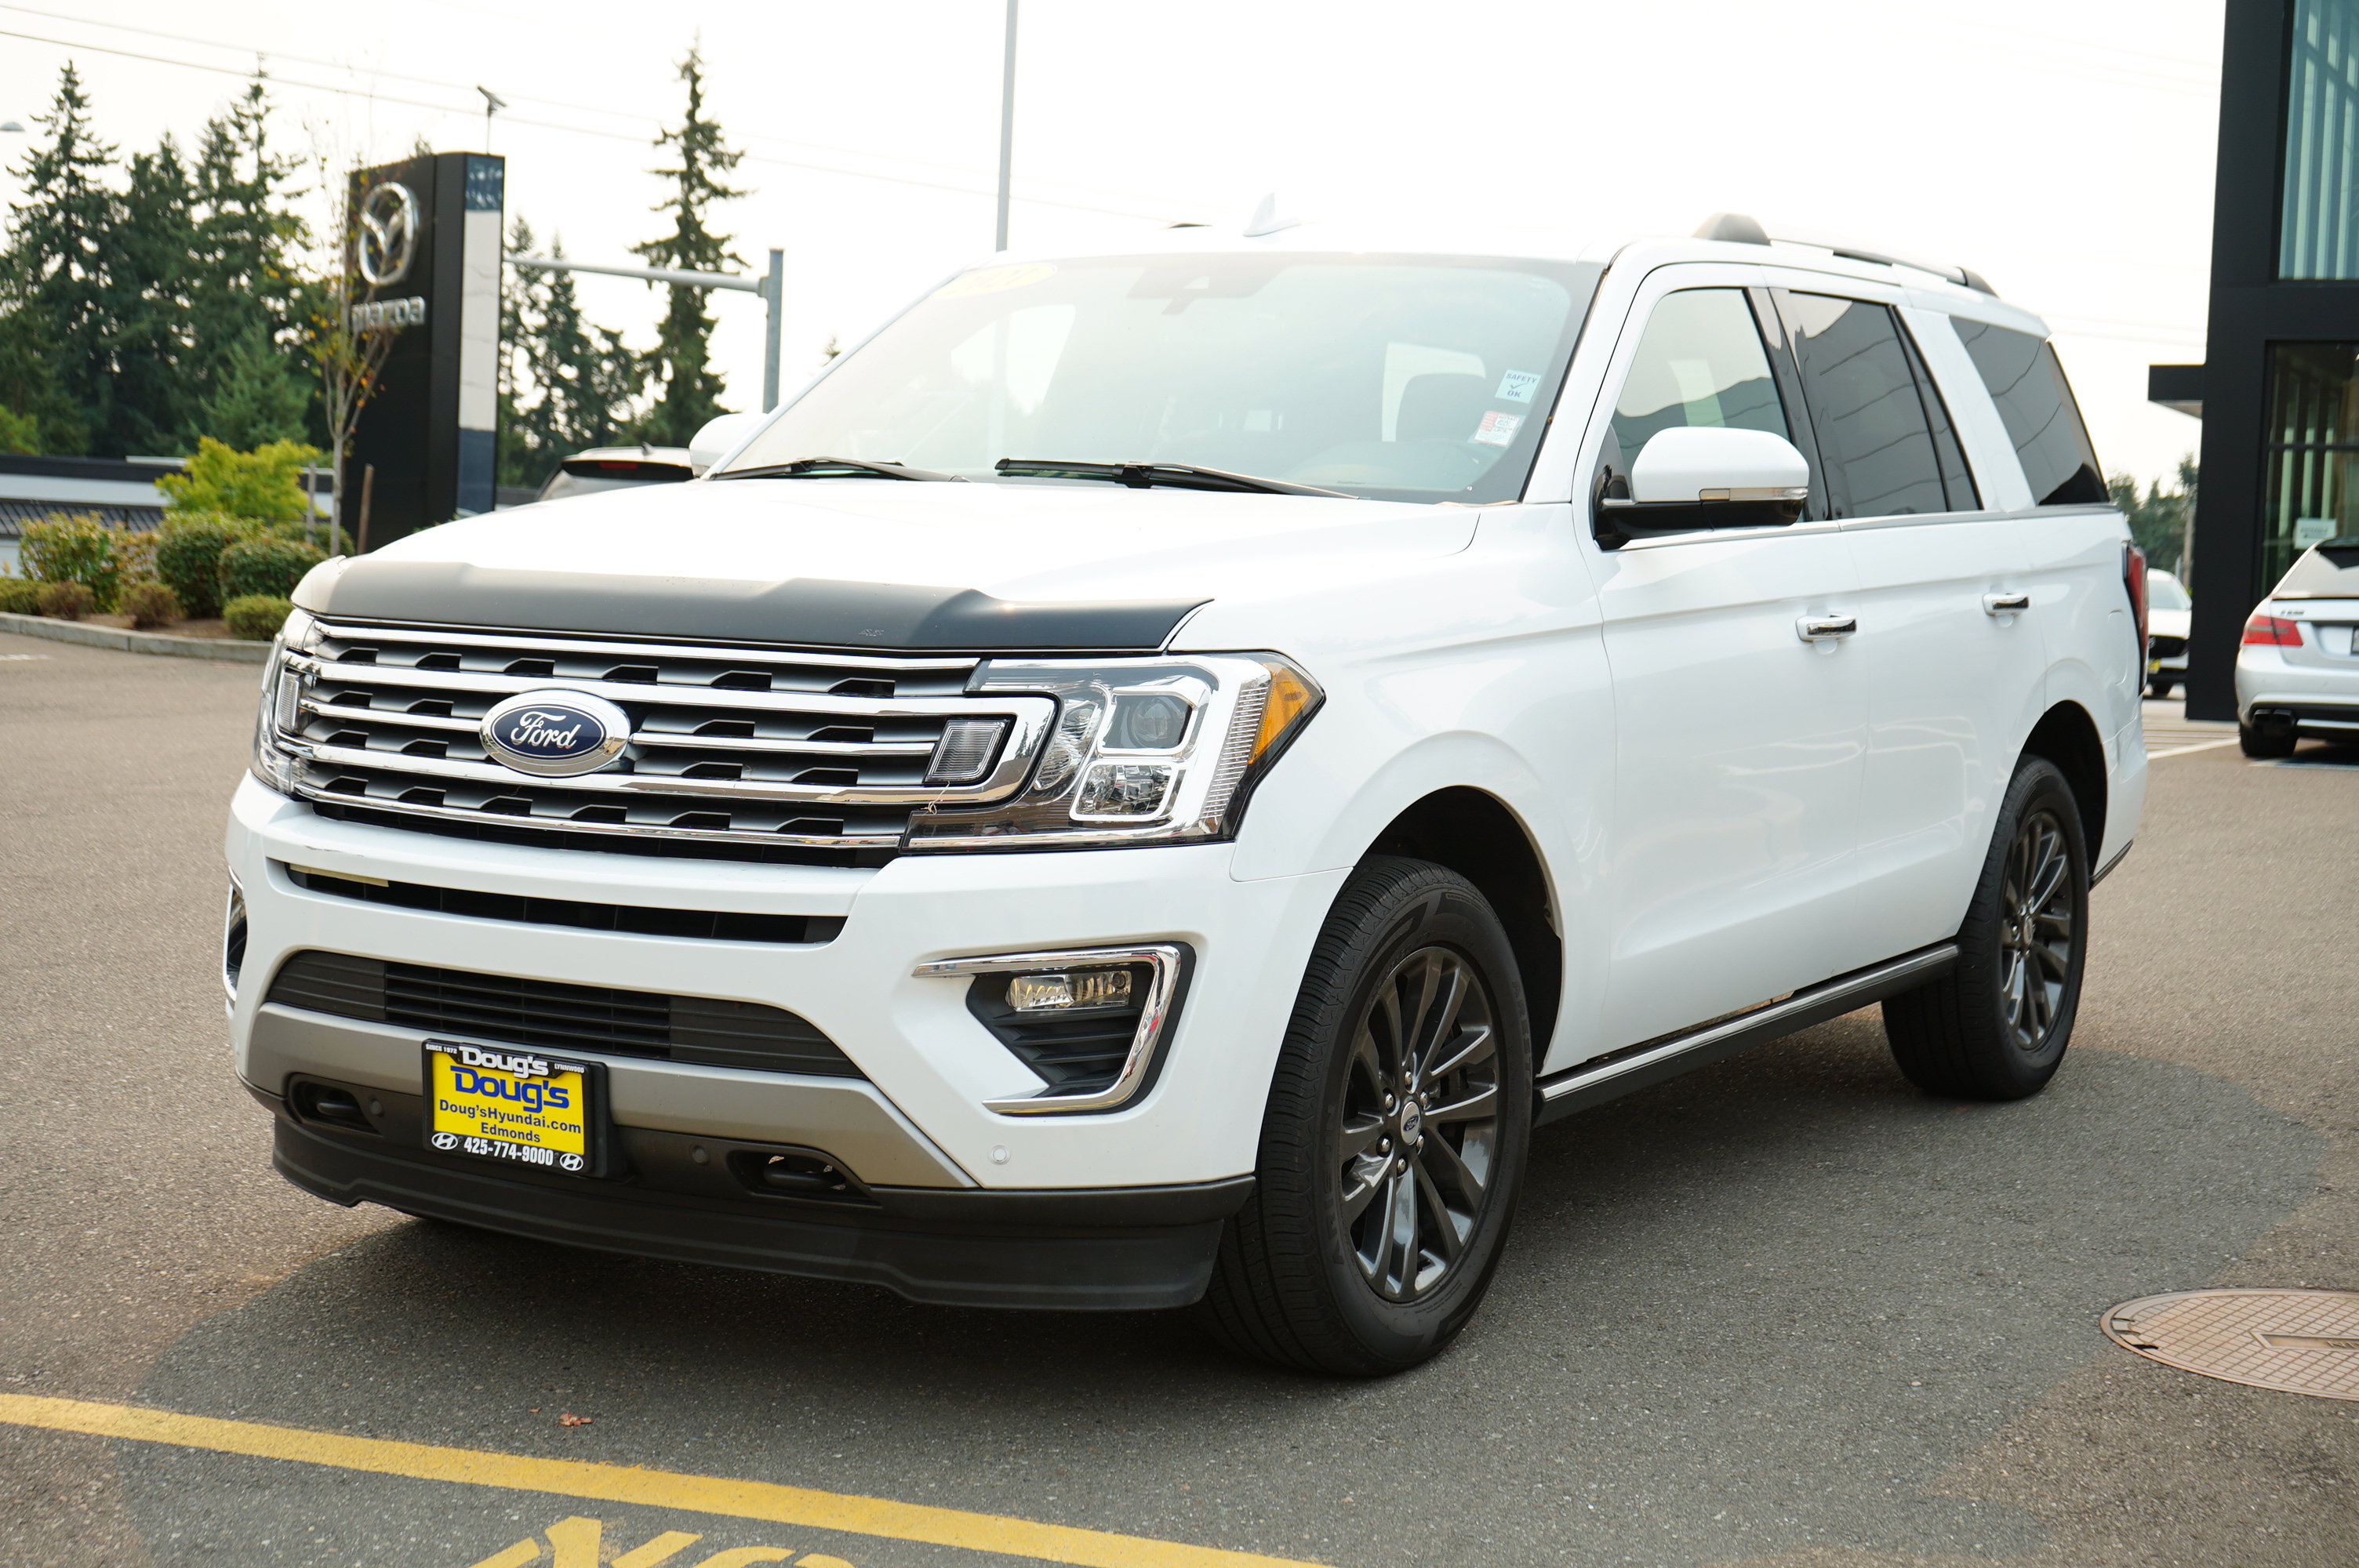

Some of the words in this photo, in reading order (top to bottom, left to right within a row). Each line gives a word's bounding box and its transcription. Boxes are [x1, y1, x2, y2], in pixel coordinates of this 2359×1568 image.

[1506, 372, 1538, 383] SAFETY
[1507, 390, 1521, 398] OK
[511, 711, 581, 750] Ford
[459, 1046, 549, 1079] Doug's
[554, 1062, 584, 1073] LYNNWOOD
[450, 1065, 570, 1113] Doug's
[481, 1122, 541, 1143] Edmonds
[463, 1136, 554, 1166] 425-774-9000
